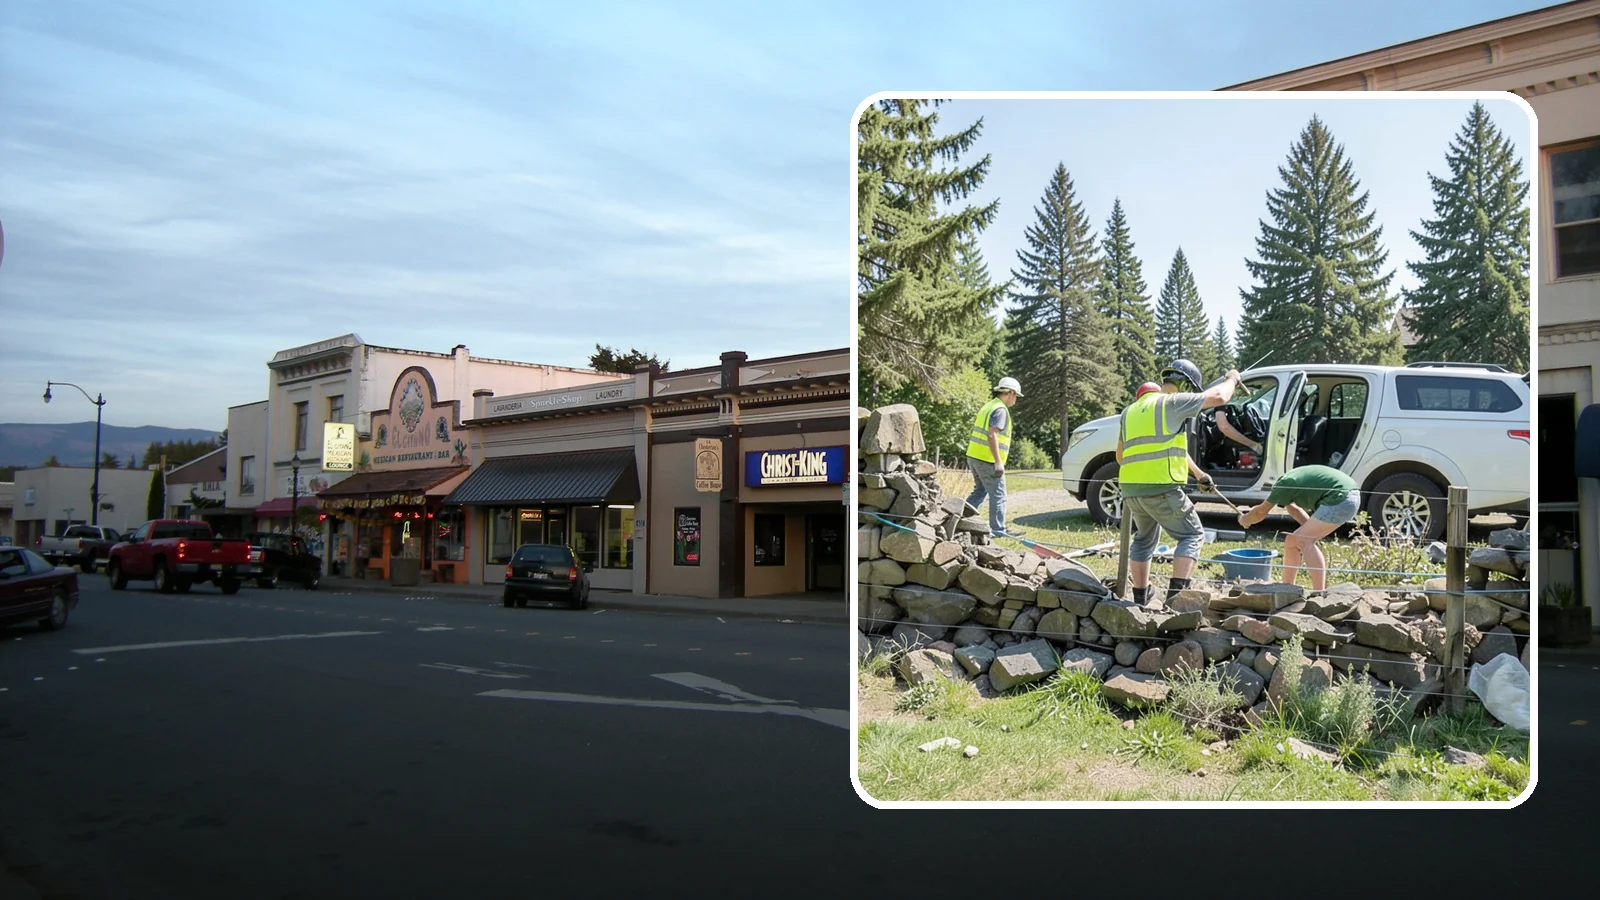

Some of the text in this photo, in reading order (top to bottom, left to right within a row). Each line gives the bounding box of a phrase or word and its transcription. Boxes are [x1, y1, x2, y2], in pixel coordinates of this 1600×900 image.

[595, 389, 624, 400] LAUNDRY
[561, 395, 582, 405] Shop
[494, 402, 522, 412] LAVANDERIA
[373, 454, 396, 464] MEXICAN
[398, 452, 433, 462] RESTAURANT
[438, 450, 449, 458] BAR
[761, 450, 827, 477] CHRIST KING
[697, 481, 709, 489] Coffee
